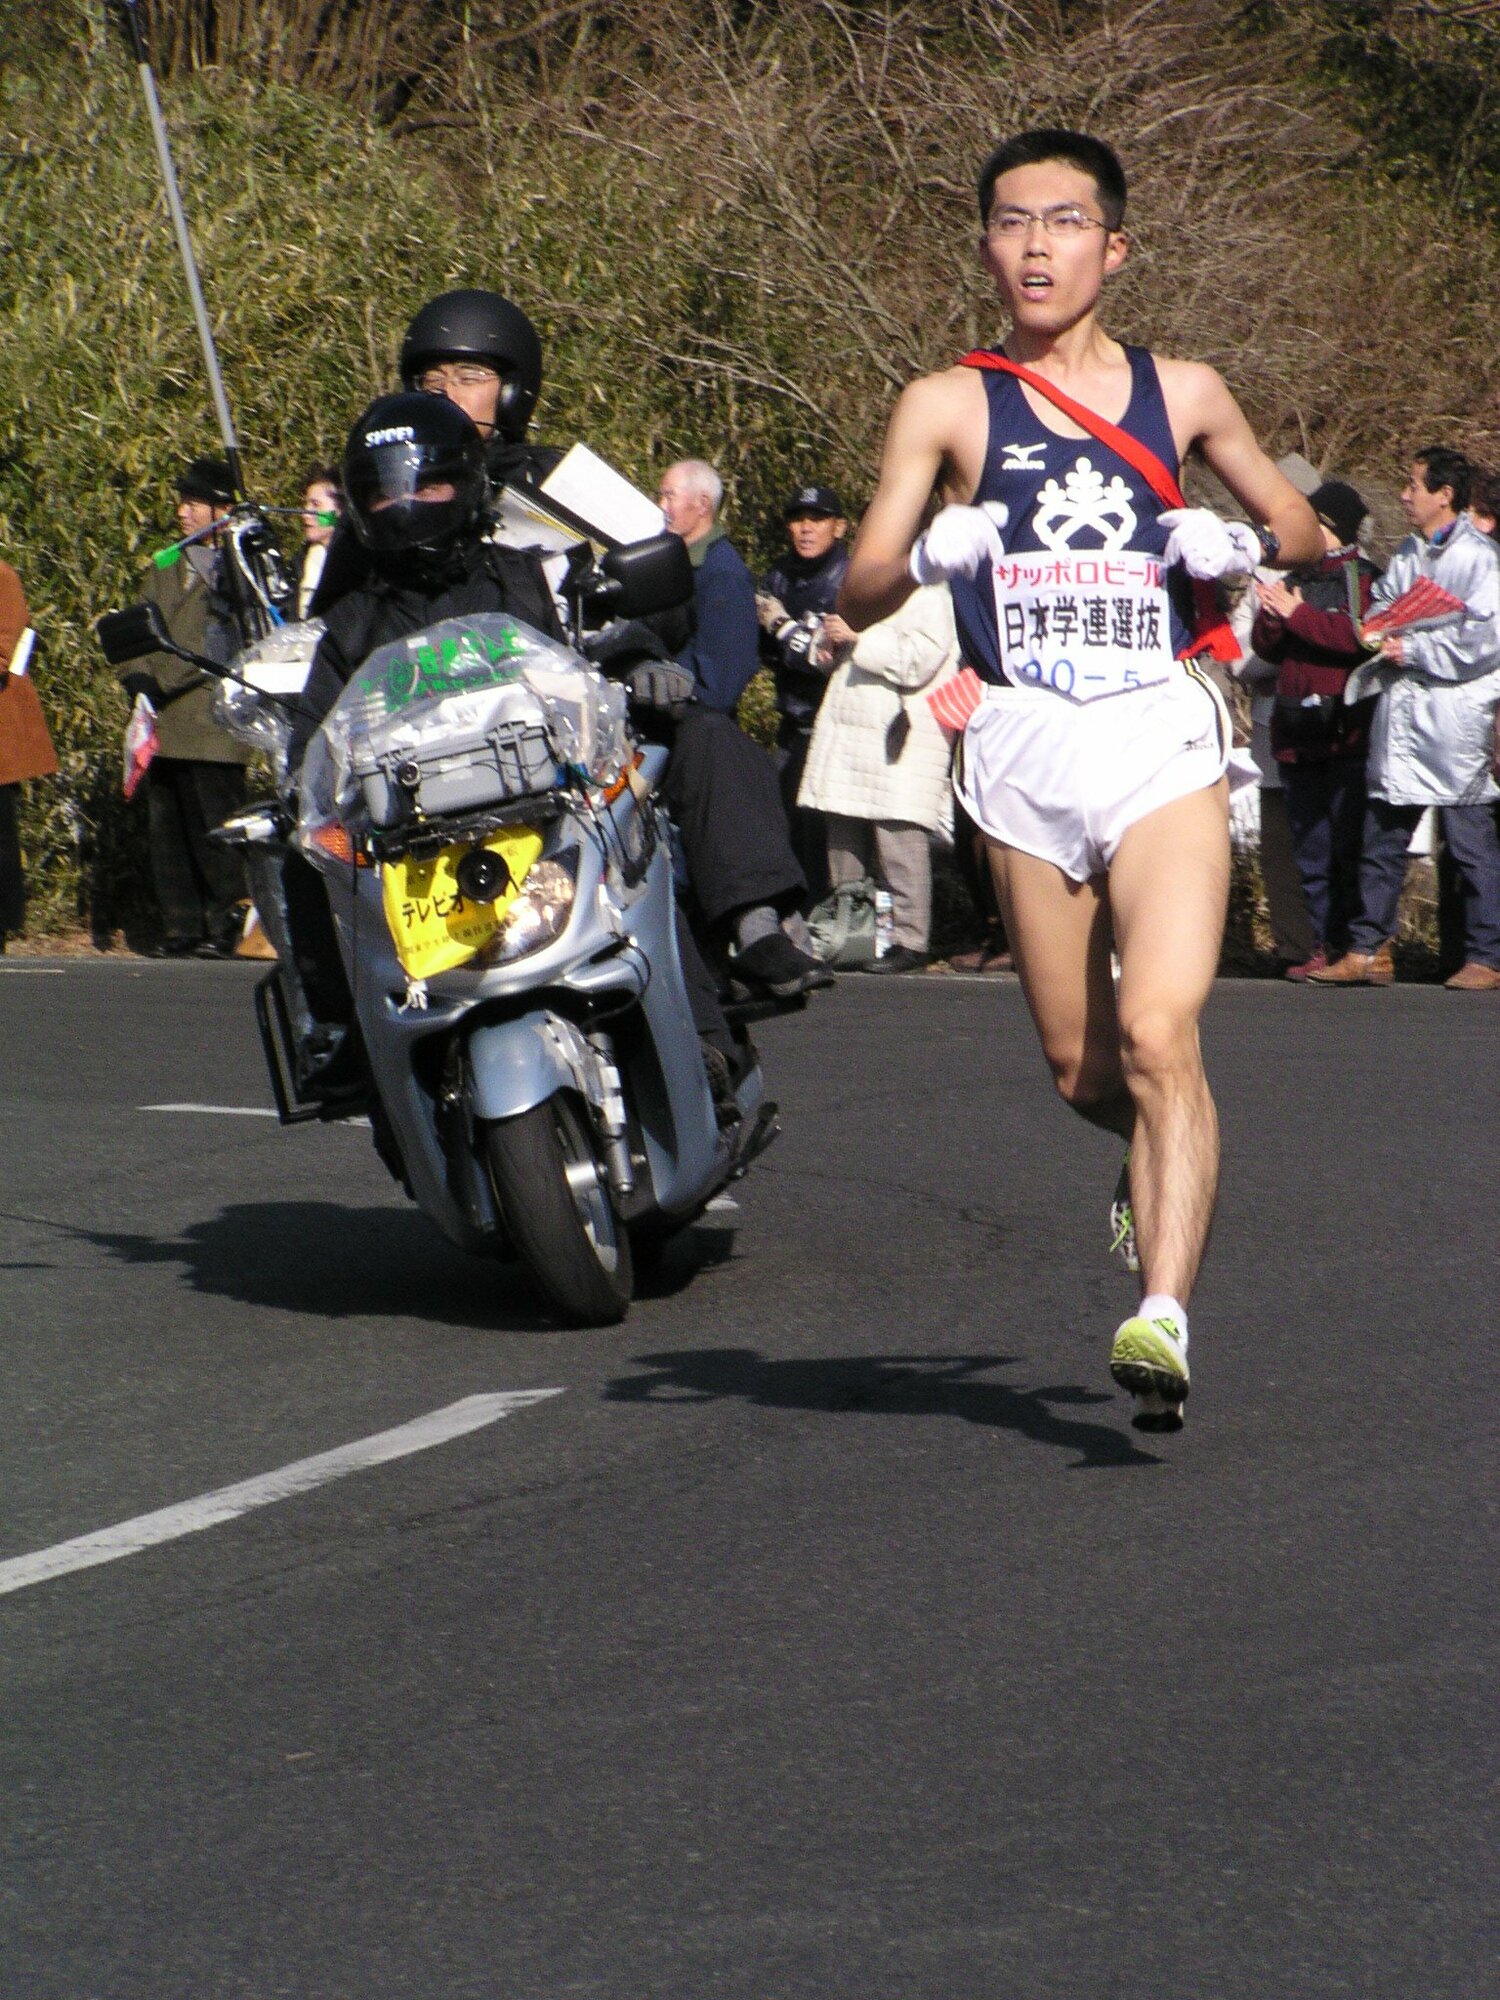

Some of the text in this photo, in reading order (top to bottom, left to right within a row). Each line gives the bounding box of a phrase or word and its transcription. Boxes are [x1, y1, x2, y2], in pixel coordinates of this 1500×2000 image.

[996, 558, 1167, 589] サッポロビール
[1004, 595, 1162, 650] 日本学連選抜
